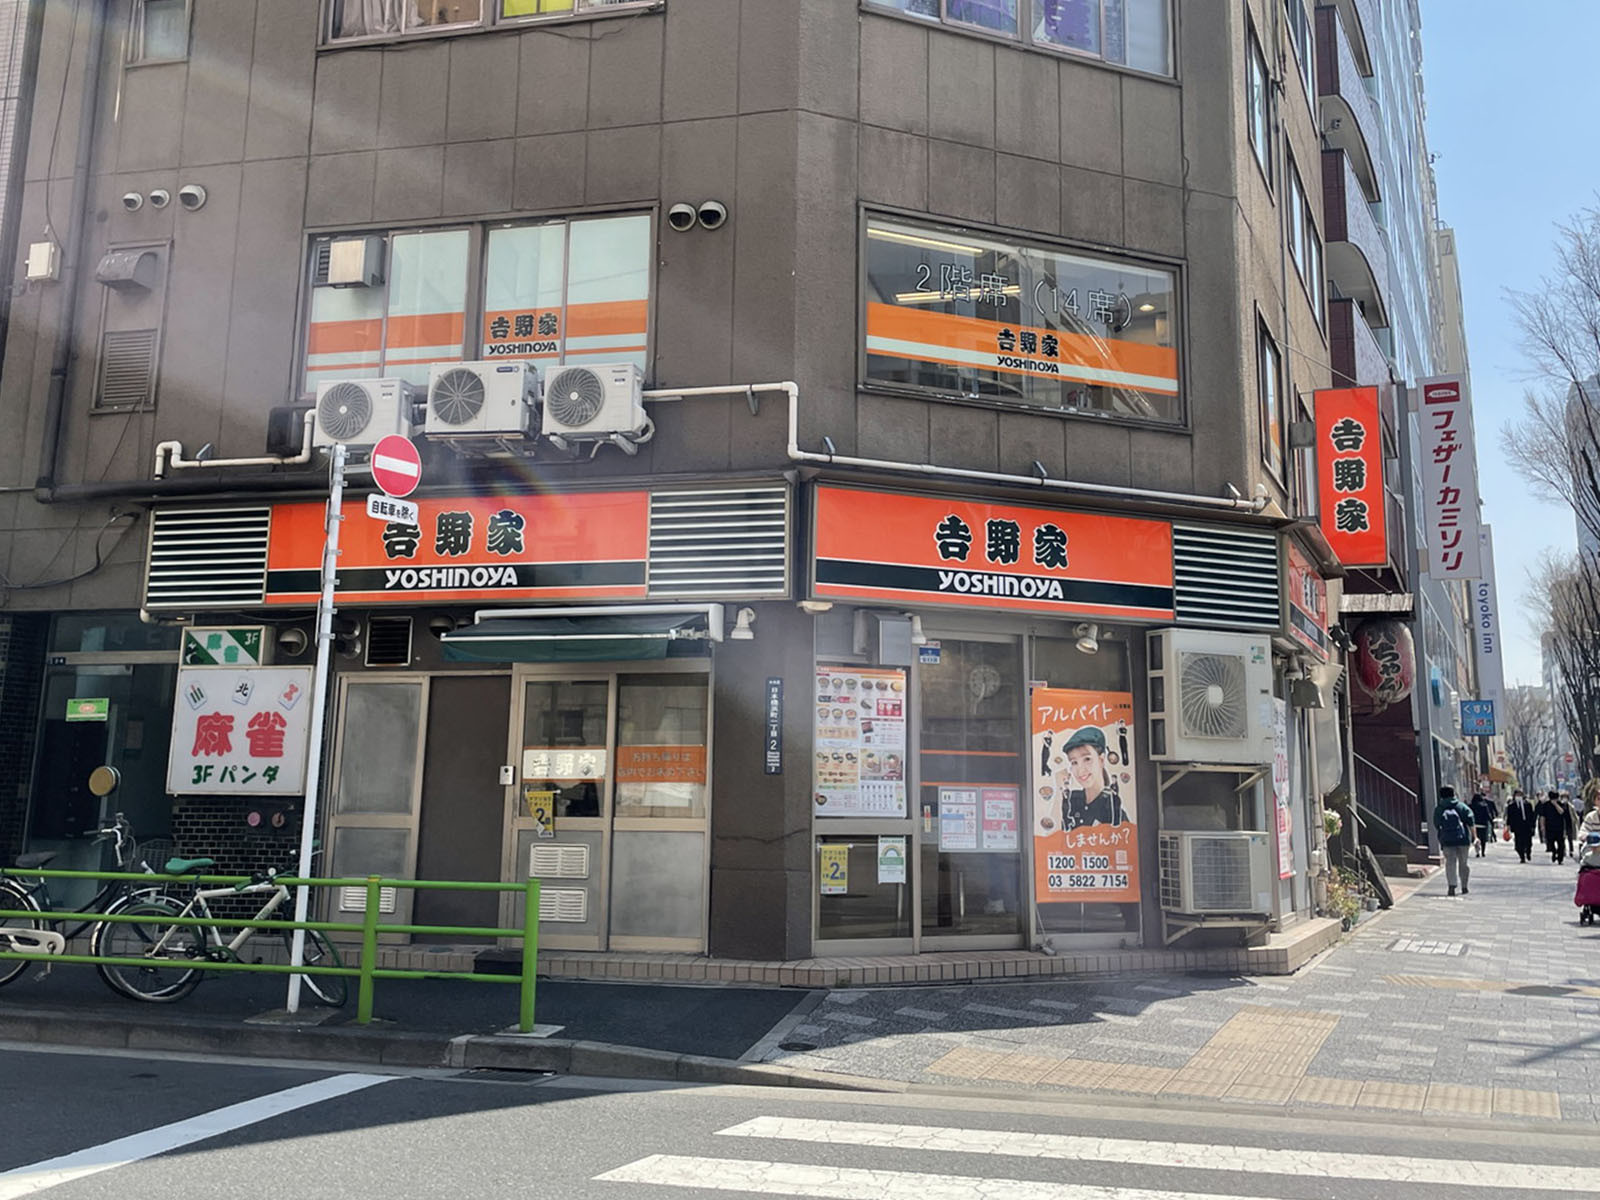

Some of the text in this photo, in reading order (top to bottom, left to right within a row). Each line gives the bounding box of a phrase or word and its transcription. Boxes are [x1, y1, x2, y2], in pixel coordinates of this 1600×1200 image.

[490, 312, 559, 339] 吉野家
[489, 340, 558, 355] YOSHINOYA
[996, 328, 1059, 358] 吉野家
[997, 355, 1059, 375] YOSHINOYA
[1330, 417, 1369, 533] 吉野家
[1431, 410, 1464, 571] フェザーカミソリ
[371, 500, 414, 521] 自転車を除く
[382, 509, 526, 560] 吉野家
[934, 514, 1069, 570] 吉野家
[384, 566, 518, 589] YOSHINOYA
[938, 570, 1064, 599] YOSHINOYA
[1477, 583, 1495, 654] toyoko inn
[245, 632, 259, 646] 3F
[1037, 703, 1113, 725] アルバイト
[191, 711, 287, 758] 麻雀
[770, 739, 777, 750] 2
[1065, 828, 1131, 850] しませんか?
[1049, 857, 1109, 870] 1200 1500
[1048, 875, 1128, 887] 03 5822 7154
